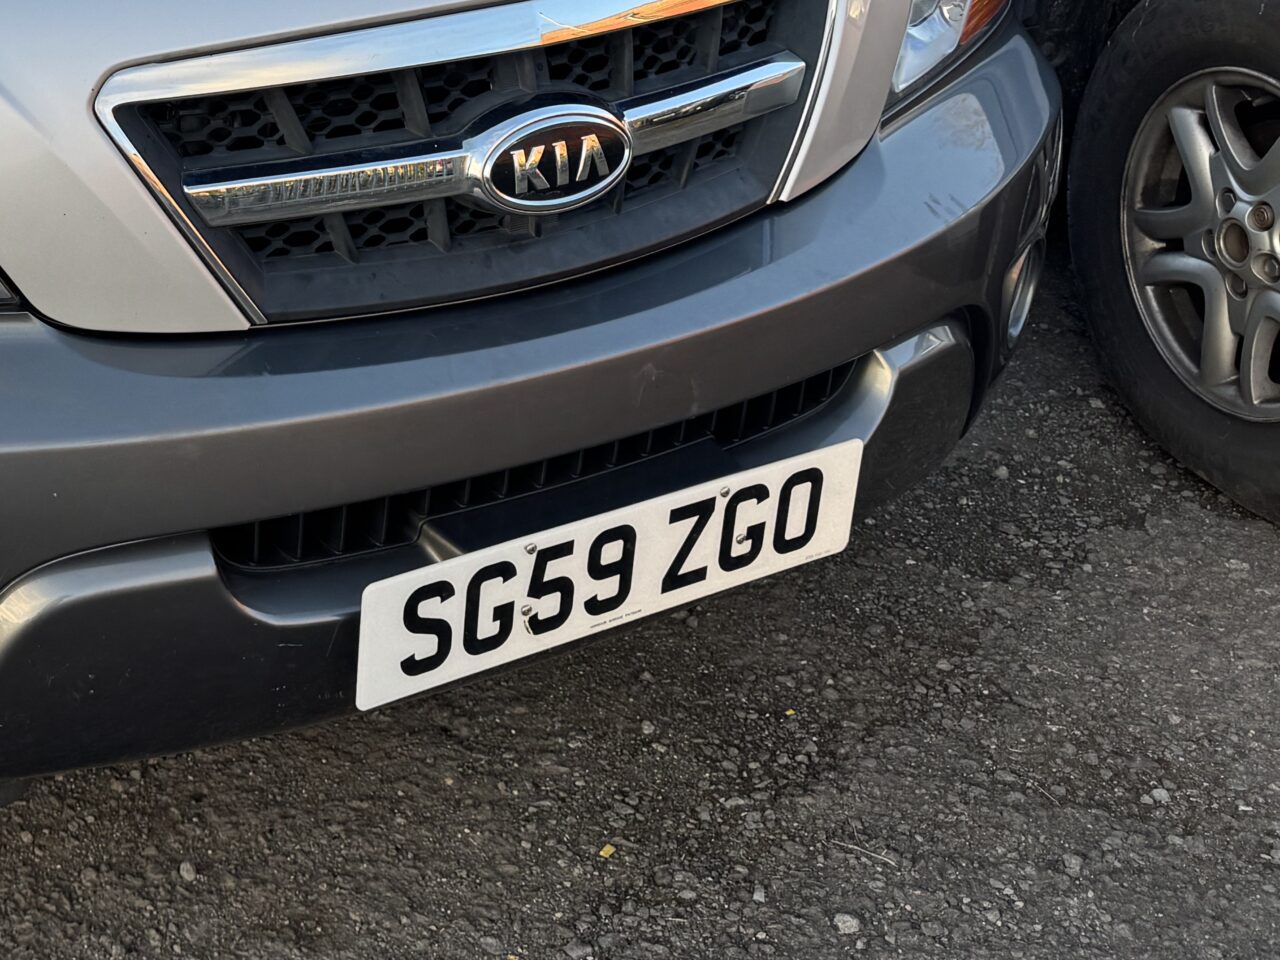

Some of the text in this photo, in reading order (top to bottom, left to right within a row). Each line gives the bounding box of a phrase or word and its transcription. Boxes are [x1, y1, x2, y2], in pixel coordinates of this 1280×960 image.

[509, 133, 611, 195] KIA
[400, 467, 824, 677] SG59 ZGO
